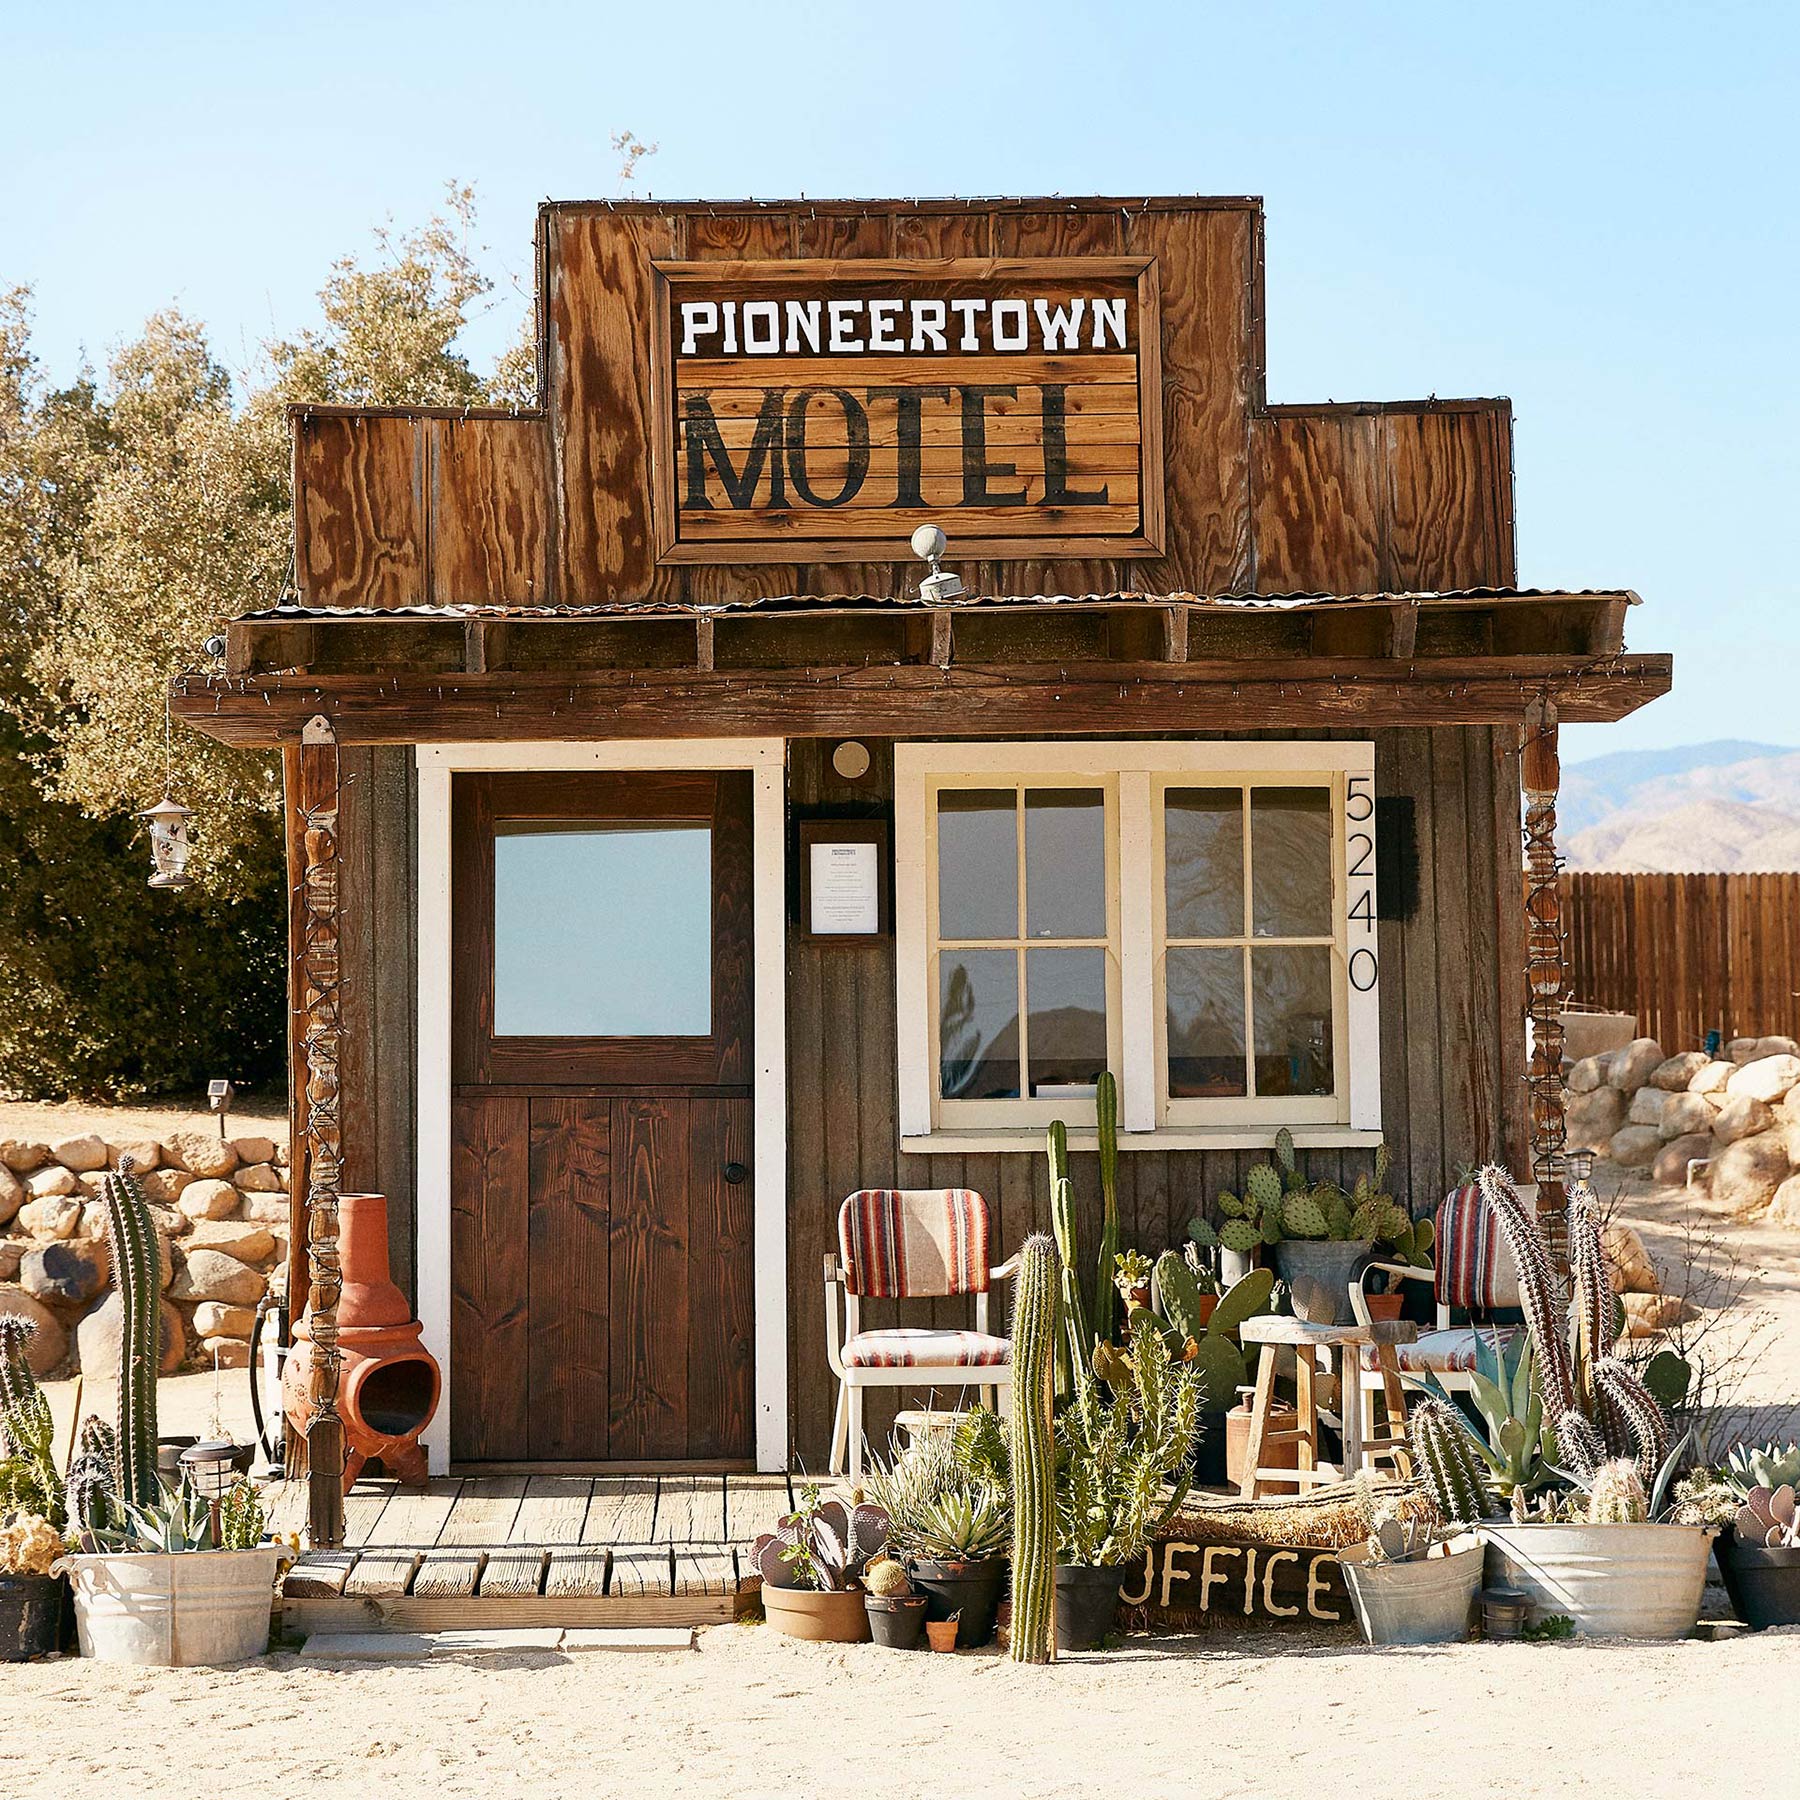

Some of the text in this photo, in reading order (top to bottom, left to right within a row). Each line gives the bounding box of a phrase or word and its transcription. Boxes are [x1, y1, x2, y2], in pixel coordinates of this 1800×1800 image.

[680, 299, 1128, 355] PIONEERTOWN
[682, 384, 1109, 510] MOTEL
[1346, 778, 1378, 992] 52240
